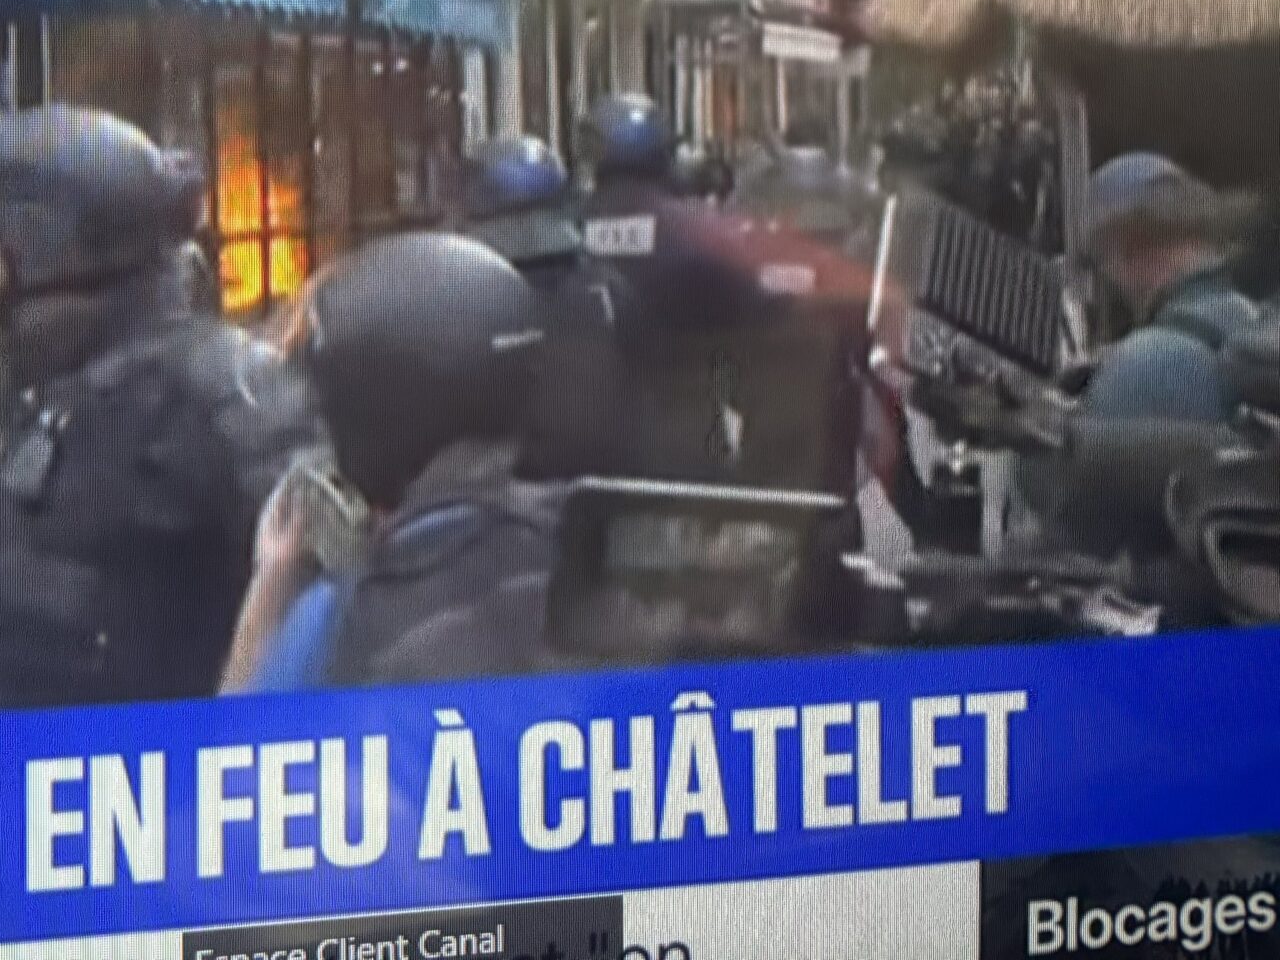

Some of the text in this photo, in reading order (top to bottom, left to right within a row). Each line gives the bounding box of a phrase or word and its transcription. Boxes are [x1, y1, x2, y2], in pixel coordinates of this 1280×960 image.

[24, 750, 166, 893] EN
[195, 734, 389, 879] FEU
[417, 708, 492, 861] À
[517, 689, 1029, 852] CHÂTELET
[418, 923, 505, 958] Canal
[1026, 890, 1277, 956] Blocages
